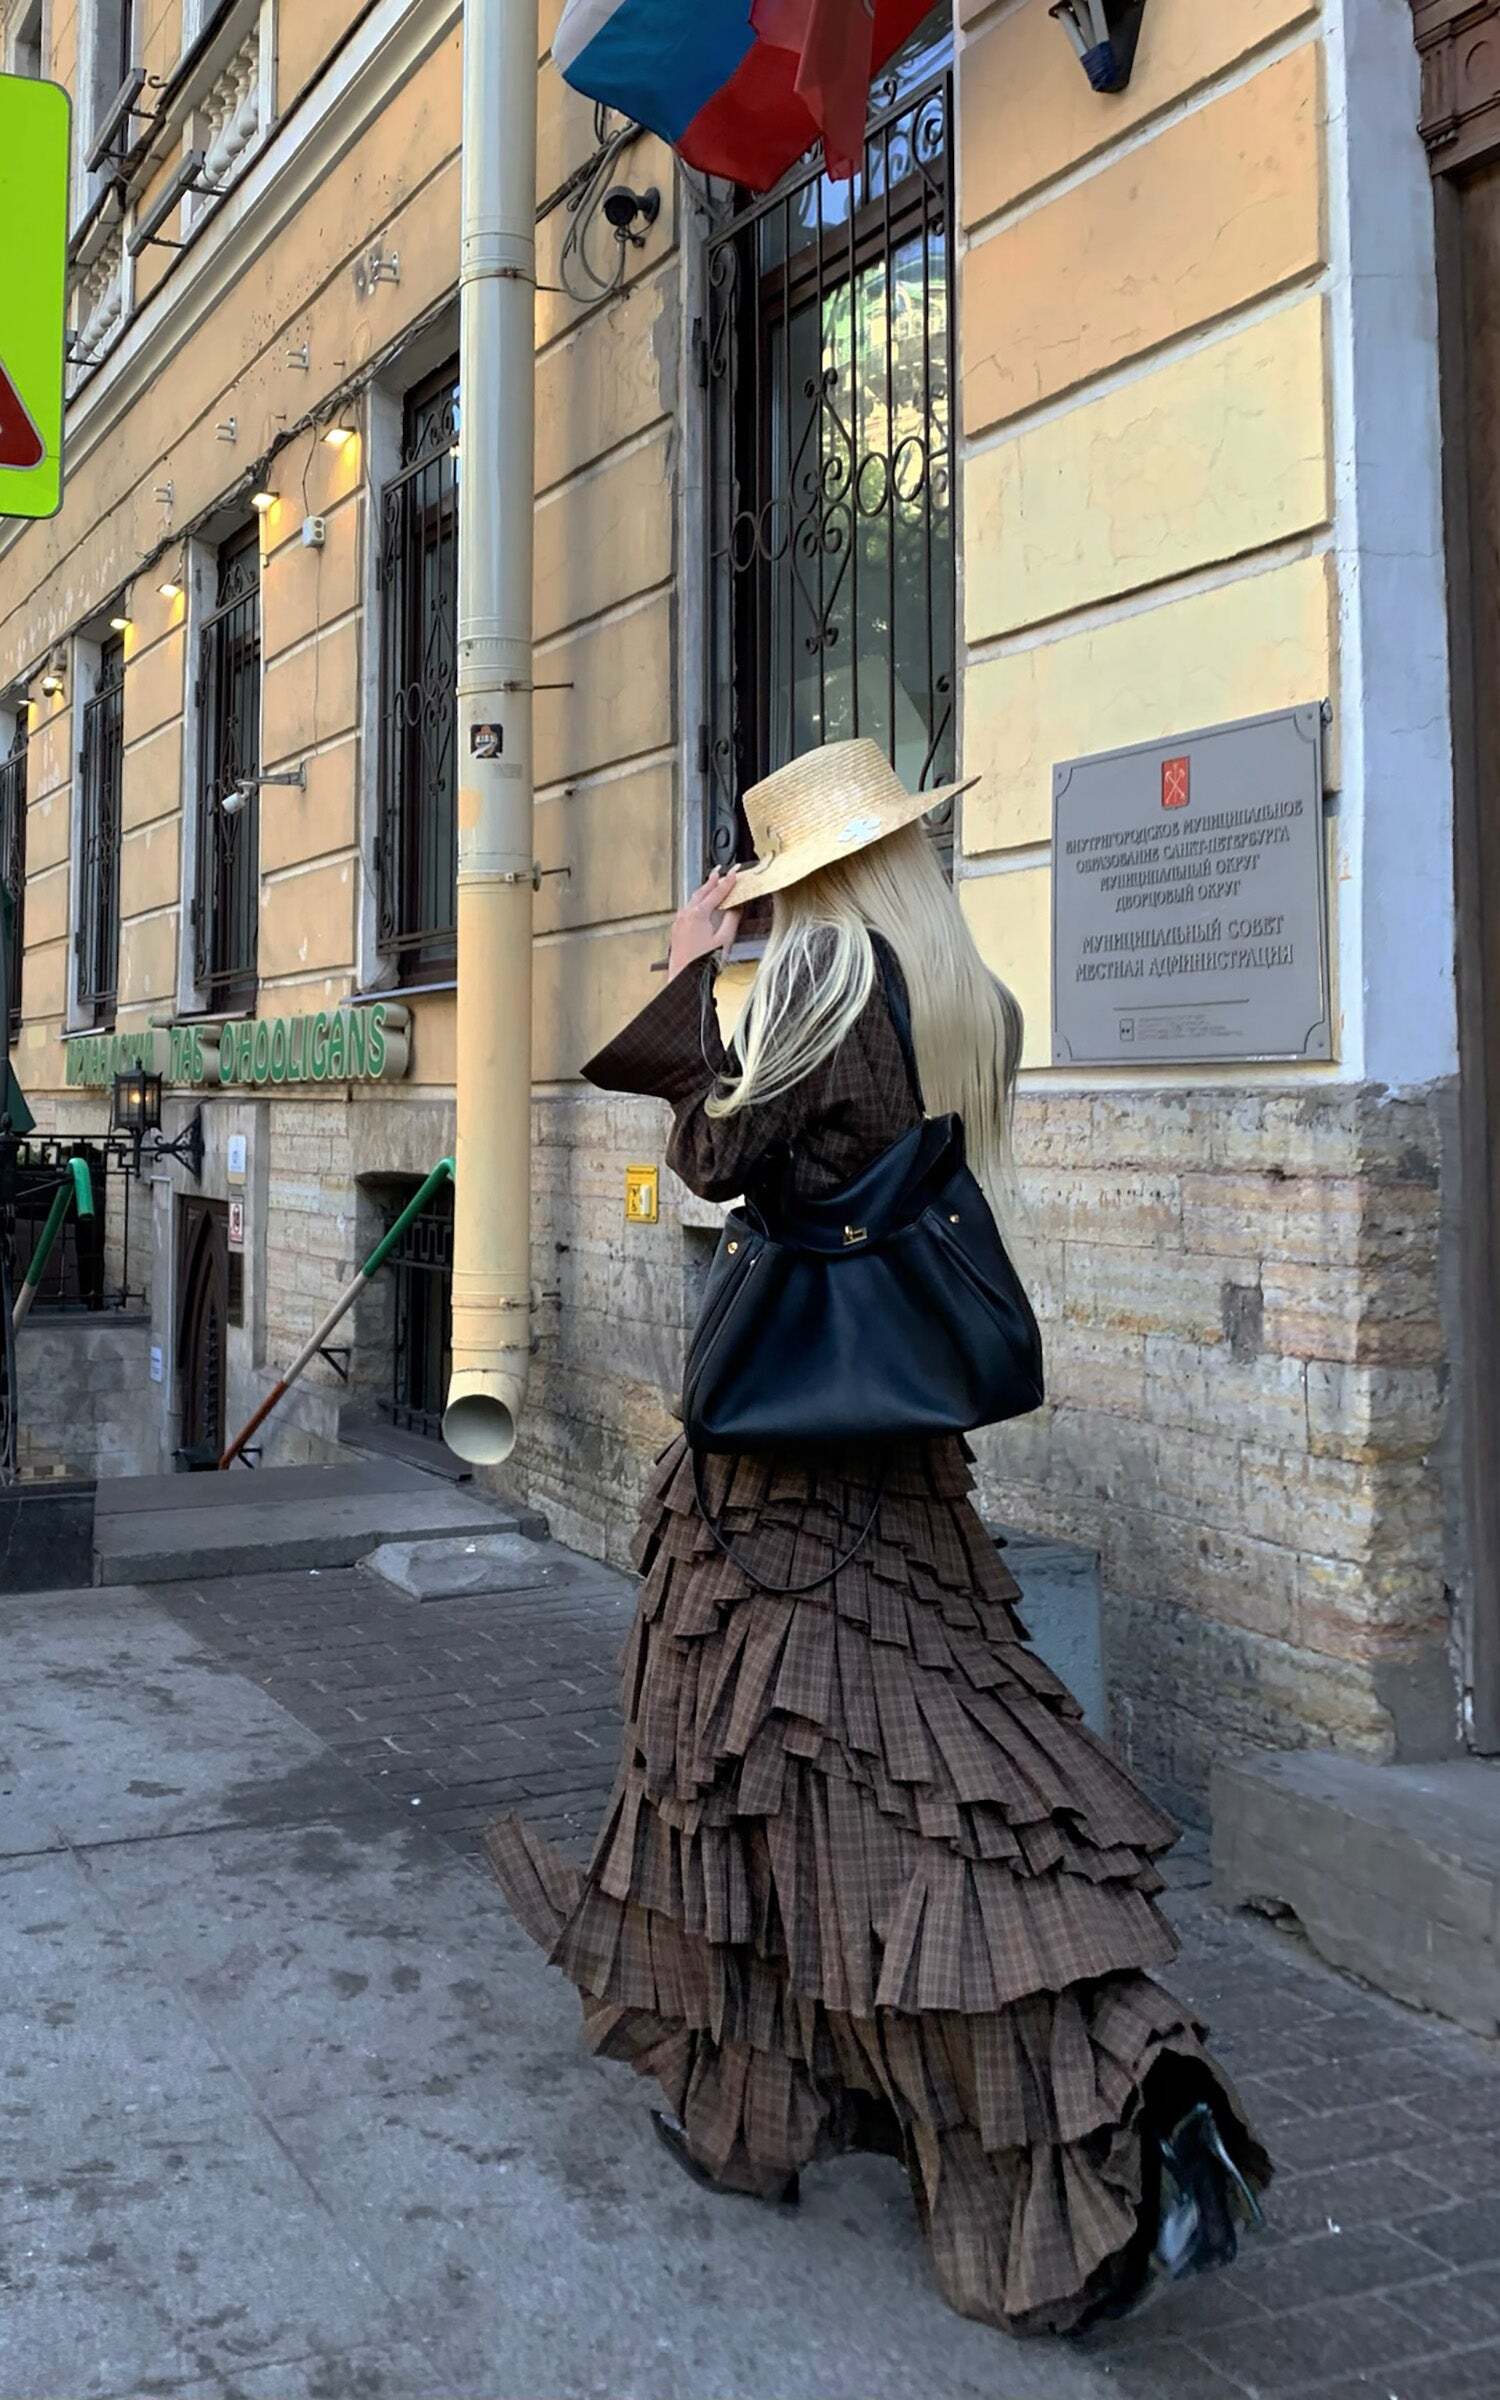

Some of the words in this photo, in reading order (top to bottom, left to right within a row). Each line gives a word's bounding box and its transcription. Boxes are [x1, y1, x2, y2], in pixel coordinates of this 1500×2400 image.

[1183, 800, 1304, 835] МУНИЦИПАЛЬНОЕ
[1076, 847, 1160, 874] ОБРАЗОВАНИЕ
[1163, 825, 1290, 861] САНКТ-ПЕТЕРБУРГА
[1100, 858, 1212, 892] МУНИЦИПАЛЬНЫЙ
[1216, 854, 1261, 874] ОКРУГ
[1115, 883, 1195, 913] ДВОРЦОВЫЙ
[1198, 880, 1242, 903] ОКРУГ
[1082, 918, 1222, 955] МУНИЦИПАЛЬНЫЙ
[1228, 914, 1285, 940] СОВЕТ
[1076, 957, 1144, 983] МЕСТНАЯ
[1148, 944, 1294, 979] АДМИНИСТРАЦИЯ
[169, 1025, 205, 1084] ПАБ
